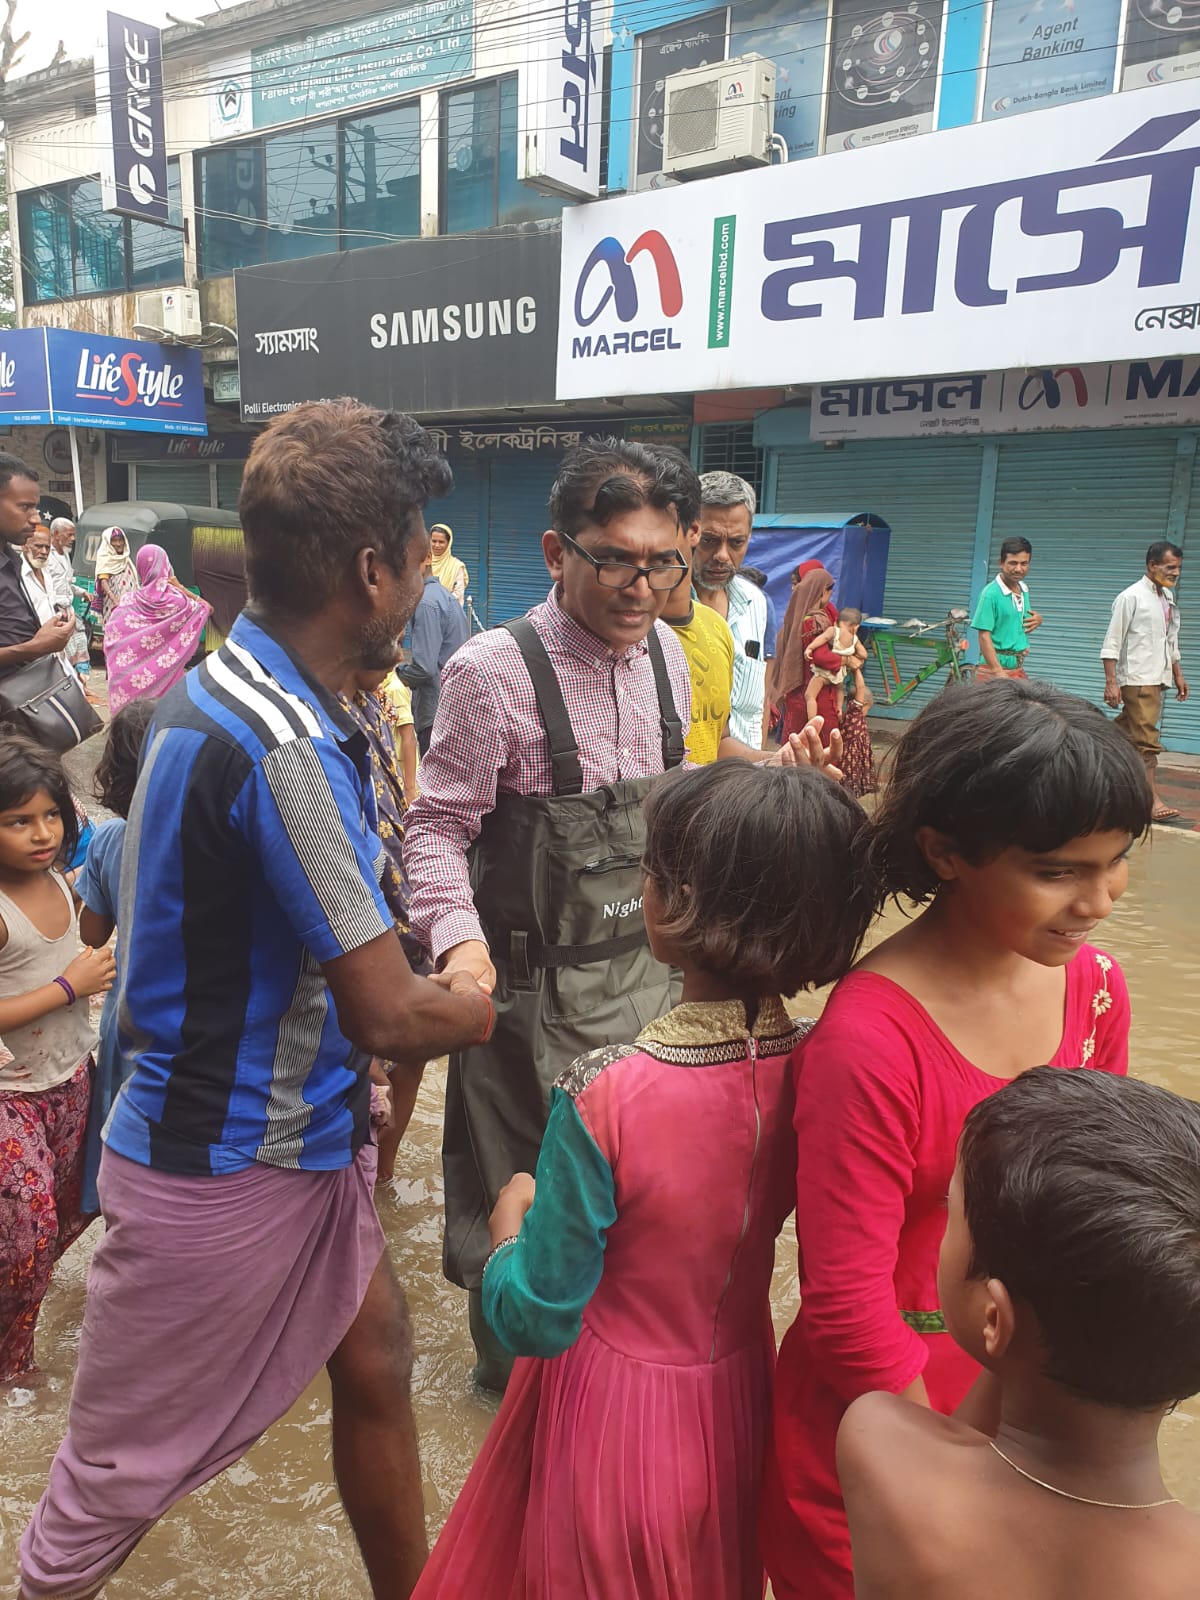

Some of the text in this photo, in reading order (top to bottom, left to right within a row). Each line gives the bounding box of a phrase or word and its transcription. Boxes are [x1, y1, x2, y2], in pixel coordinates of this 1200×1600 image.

[1032, 17, 1078, 40] Agent
[1022, 37, 1084, 61] Banking
[261, 81, 299, 101] Fareast
[334, 66, 355, 82] Life
[357, 51, 413, 76] Insurance
[416, 45, 436, 59] Co.
[440, 36, 463, 52] Ltd.
[124, 26, 153, 158] GREE
[1060, 83, 1079, 94] Bank
[1081, 77, 1107, 89] Limited
[715, 222, 730, 342] www.marcelbd.com
[254, 307, 320, 355] স্যামসাং
[370, 296, 537, 349] SAMSUNG
[1135, 302, 1200, 331] নেক্স
[571, 327, 681, 359] MARCEL
[76, 348, 184, 407] LifeStyle
[244, 403, 261, 415] Polli
[459, 426, 584, 451] ইলেকট্রনিক্স
[603, 896, 643, 920] Night
